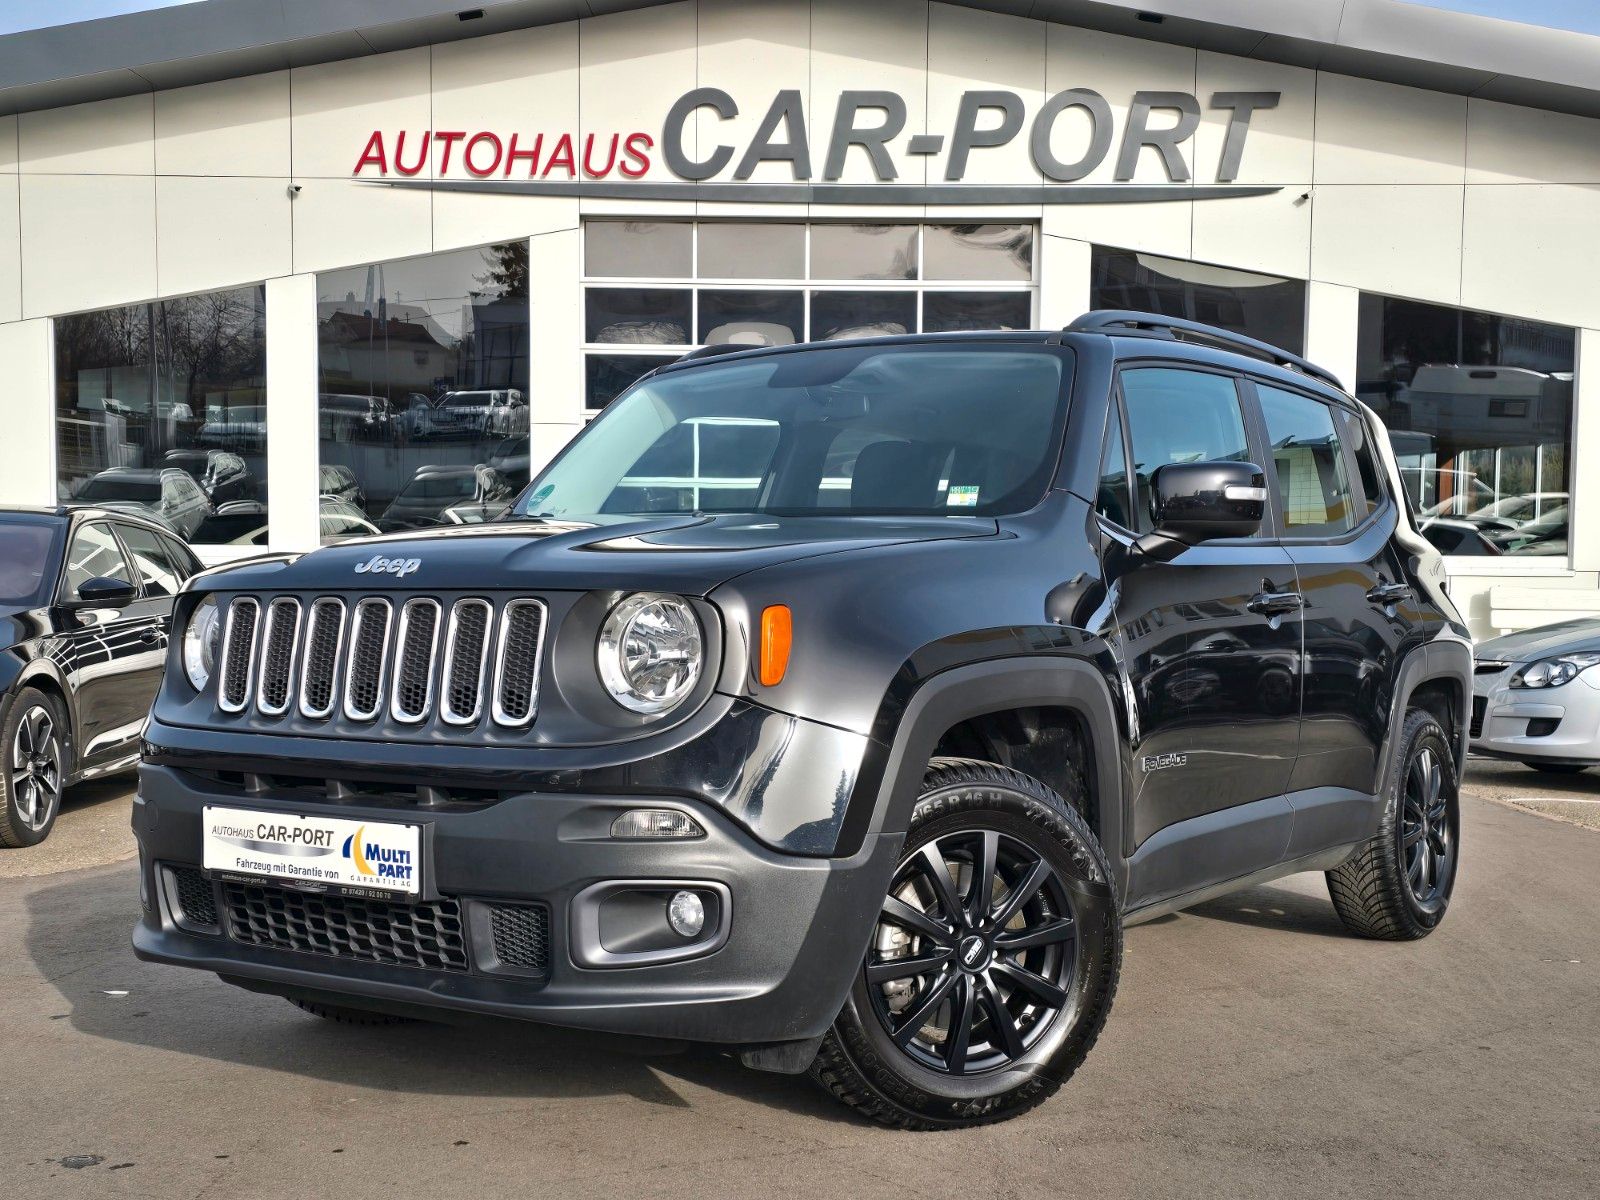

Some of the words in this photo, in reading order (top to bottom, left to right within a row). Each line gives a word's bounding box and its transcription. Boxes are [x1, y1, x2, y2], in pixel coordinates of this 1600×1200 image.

[353, 130, 654, 178] AUTOHAUS
[662, 87, 1281, 182] CAR-PORT
[354, 555, 422, 578] Jeep
[212, 825, 254, 839] AUTOHAUS
[257, 823, 334, 847] CAR-PORT
[366, 843, 411, 865] MULTI
[236, 857, 271, 873] Fahrzeug
[273, 862, 286, 873] mit
[288, 864, 322, 878] Garantie
[324, 870, 339, 880] von
[378, 863, 412, 880] PART
